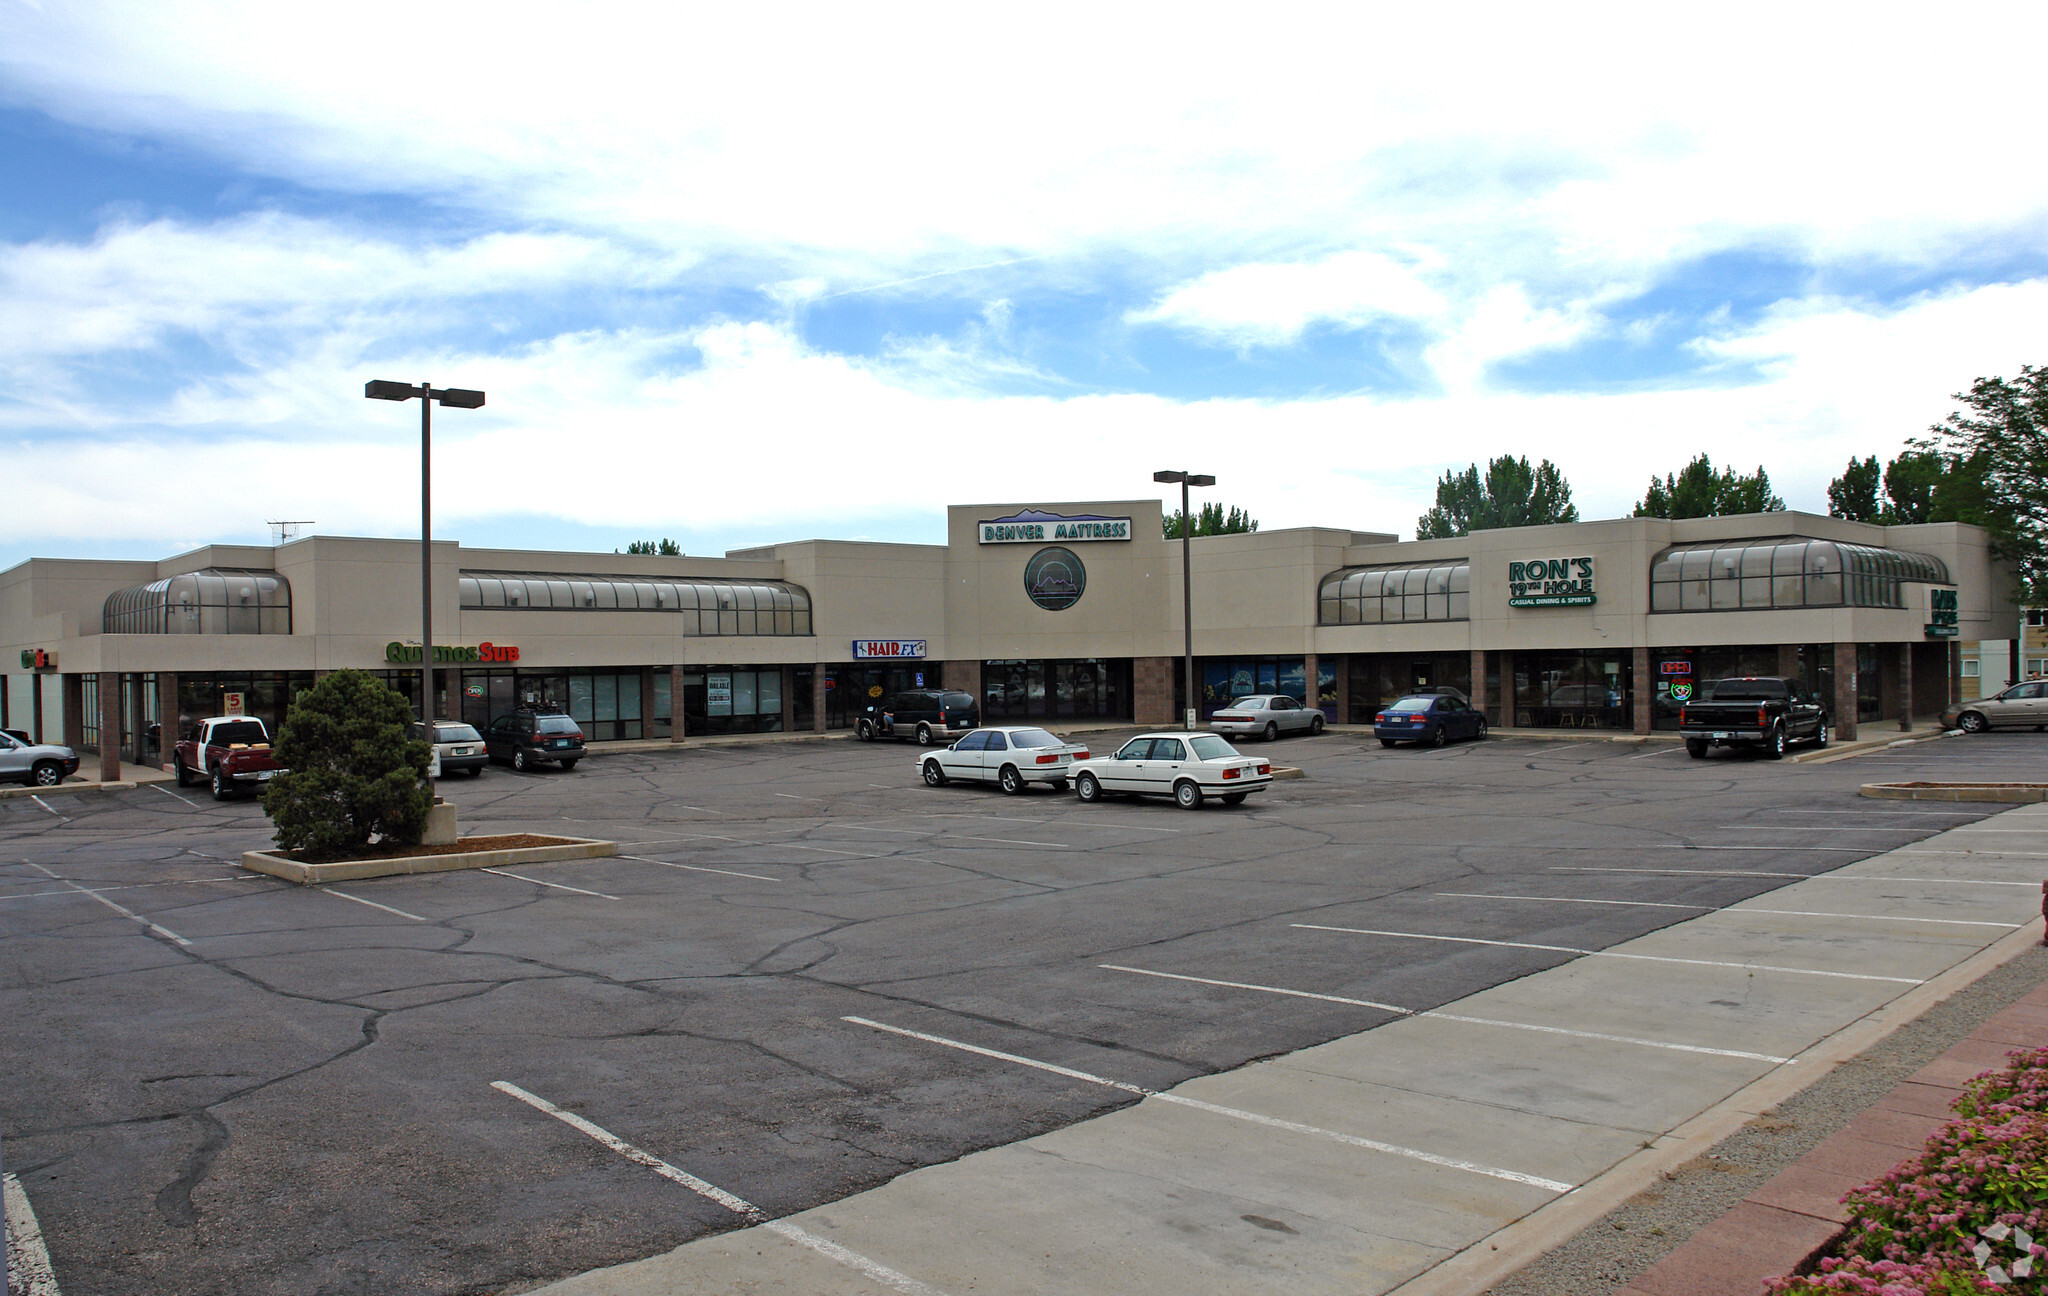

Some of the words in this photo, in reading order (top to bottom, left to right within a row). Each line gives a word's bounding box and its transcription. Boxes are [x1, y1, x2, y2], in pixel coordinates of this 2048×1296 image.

[985, 525, 1044, 540] DENVER
[1054, 522, 1126, 539] MATTRESS
[1509, 557, 1593, 581] RON'S
[1509, 582, 1541, 595] 19TH
[1544, 579, 1592, 594] HOLE
[868, 642, 899, 656] HAIR
[900, 644, 917, 656] FX
[1662, 662, 1690, 673] OPEN
